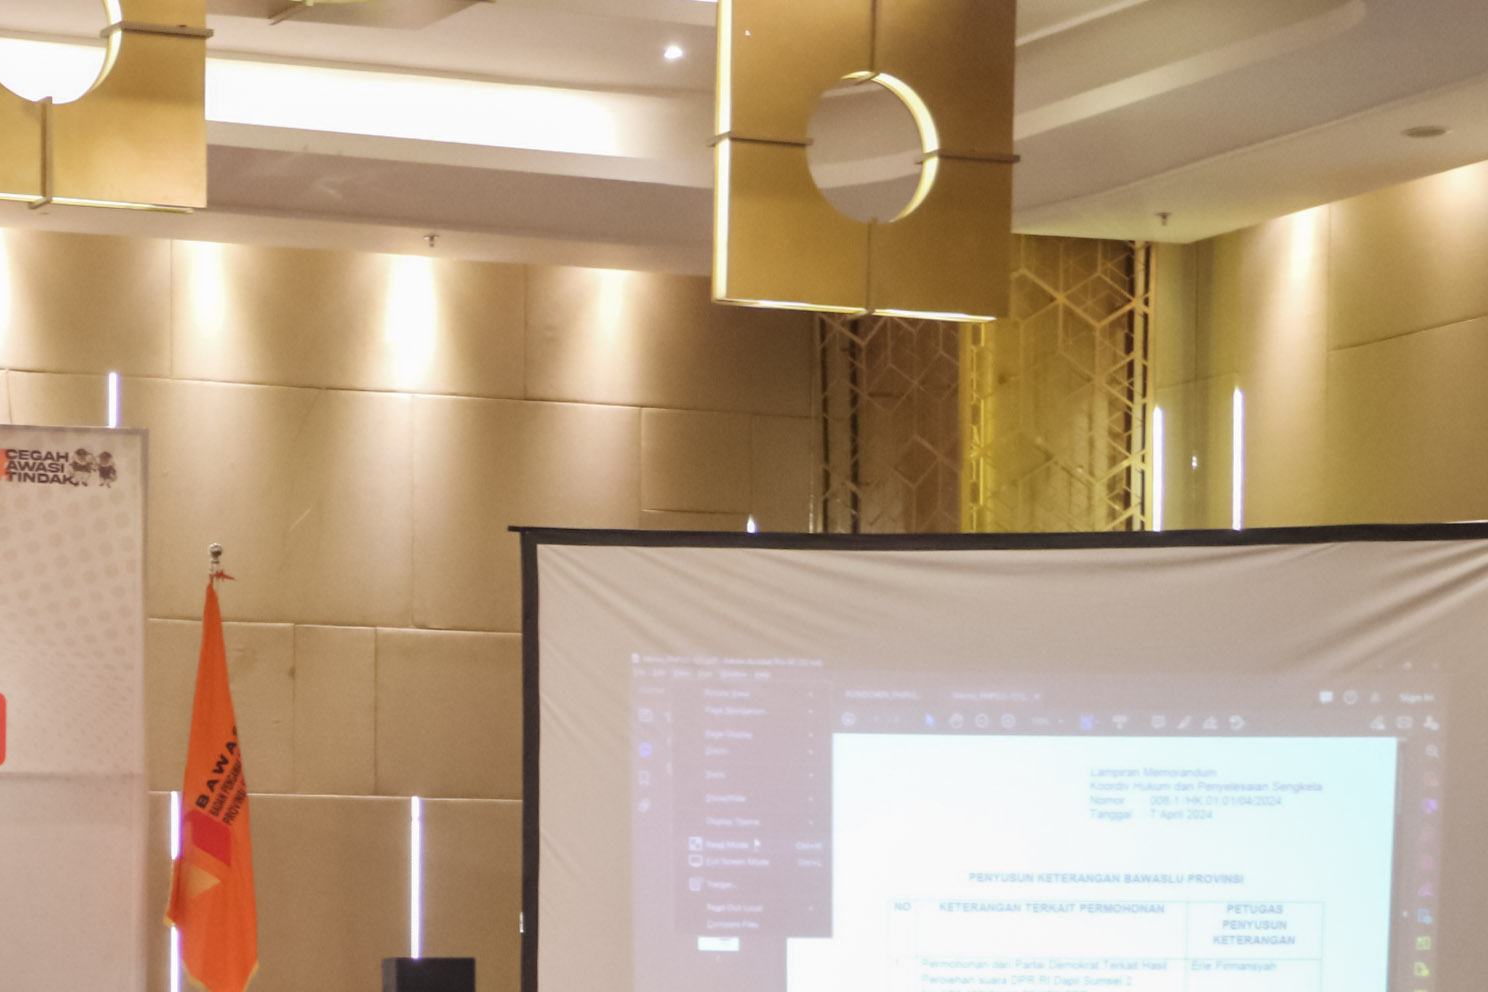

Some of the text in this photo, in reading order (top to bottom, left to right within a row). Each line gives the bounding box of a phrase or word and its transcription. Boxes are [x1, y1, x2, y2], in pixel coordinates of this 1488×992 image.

[6, 449, 69, 462] CEGAH
[6, 461, 64, 473] AWASI
[7, 472, 74, 485] TINDAK
[1091, 768, 1217, 780] Lampiran Memorandum
[1174, 782, 1194, 792] dan
[1273, 783, 1323, 794] Sengketa
[1091, 809, 1132, 821] Tanggal
[969, 872, 1244, 885] PENYUSUN KETERANGAN BAWASLU PROVINSI
[894, 902, 1165, 914] NO KETERANGAN TERKAIT PERMOHONAN
[1227, 904, 1283, 914] PETUGAS
[1222, 920, 1287, 931] PENYUSUN
[1213, 935, 1296, 946] KETERANGAN
